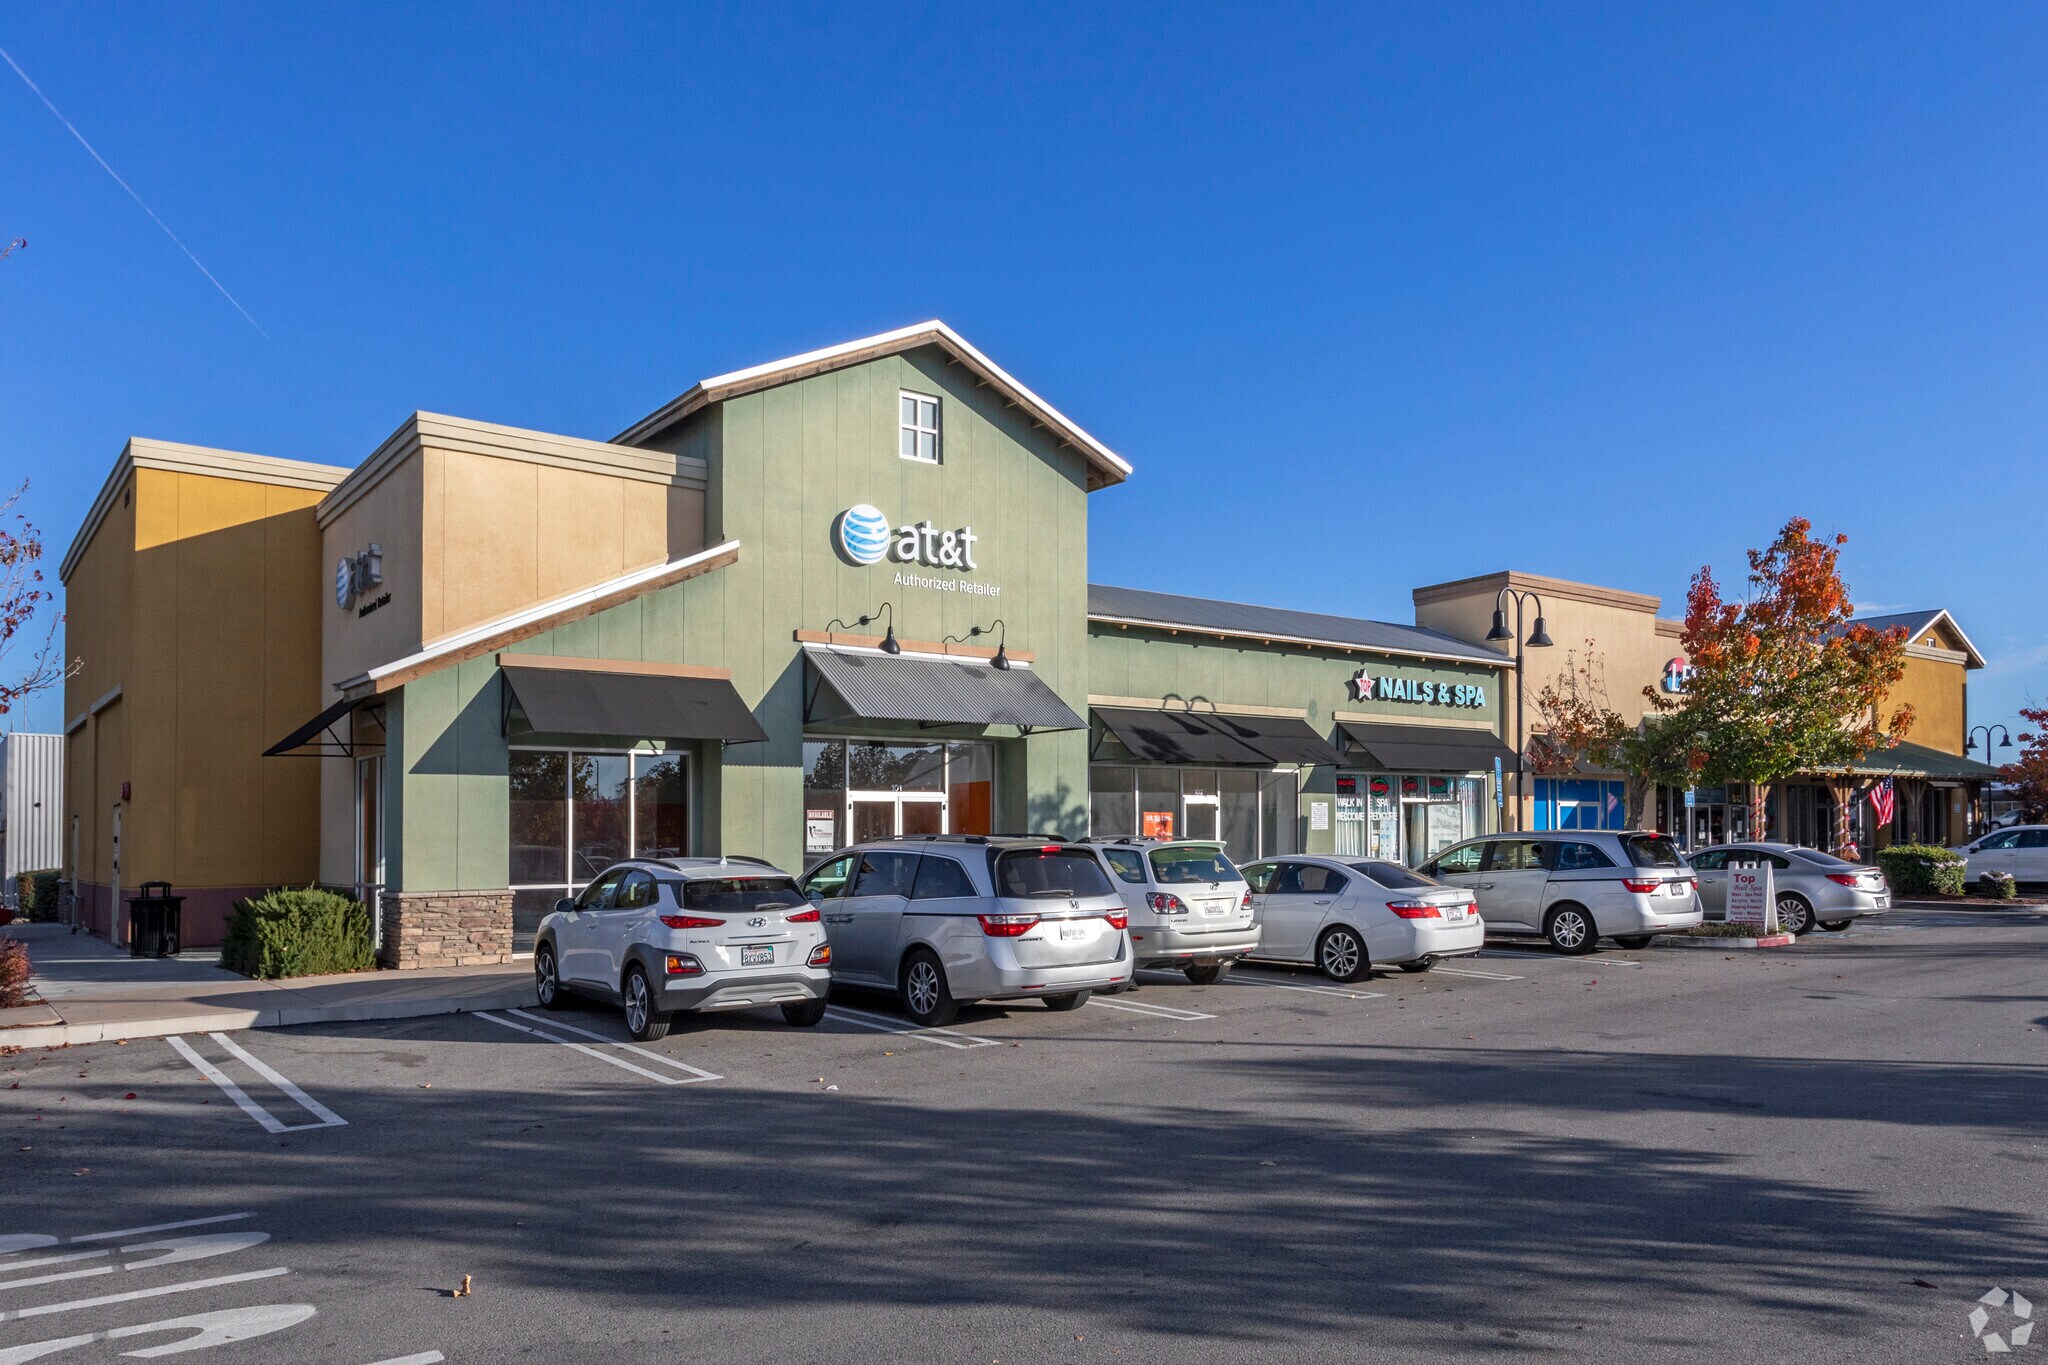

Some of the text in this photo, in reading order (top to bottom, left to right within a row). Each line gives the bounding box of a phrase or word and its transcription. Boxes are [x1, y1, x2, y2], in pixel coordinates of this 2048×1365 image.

[896, 520, 978, 570] at&t
[893, 572, 1001, 597] Authorized Retailer
[1360, 679, 1372, 693] TOP
[1379, 677, 1486, 707] NAILS & SPA
[1337, 798, 1355, 807] WALK
[1356, 798, 1363, 807] IN
[808, 811, 833, 819] AVAILABLE
[1734, 874, 1755, 885] Top
